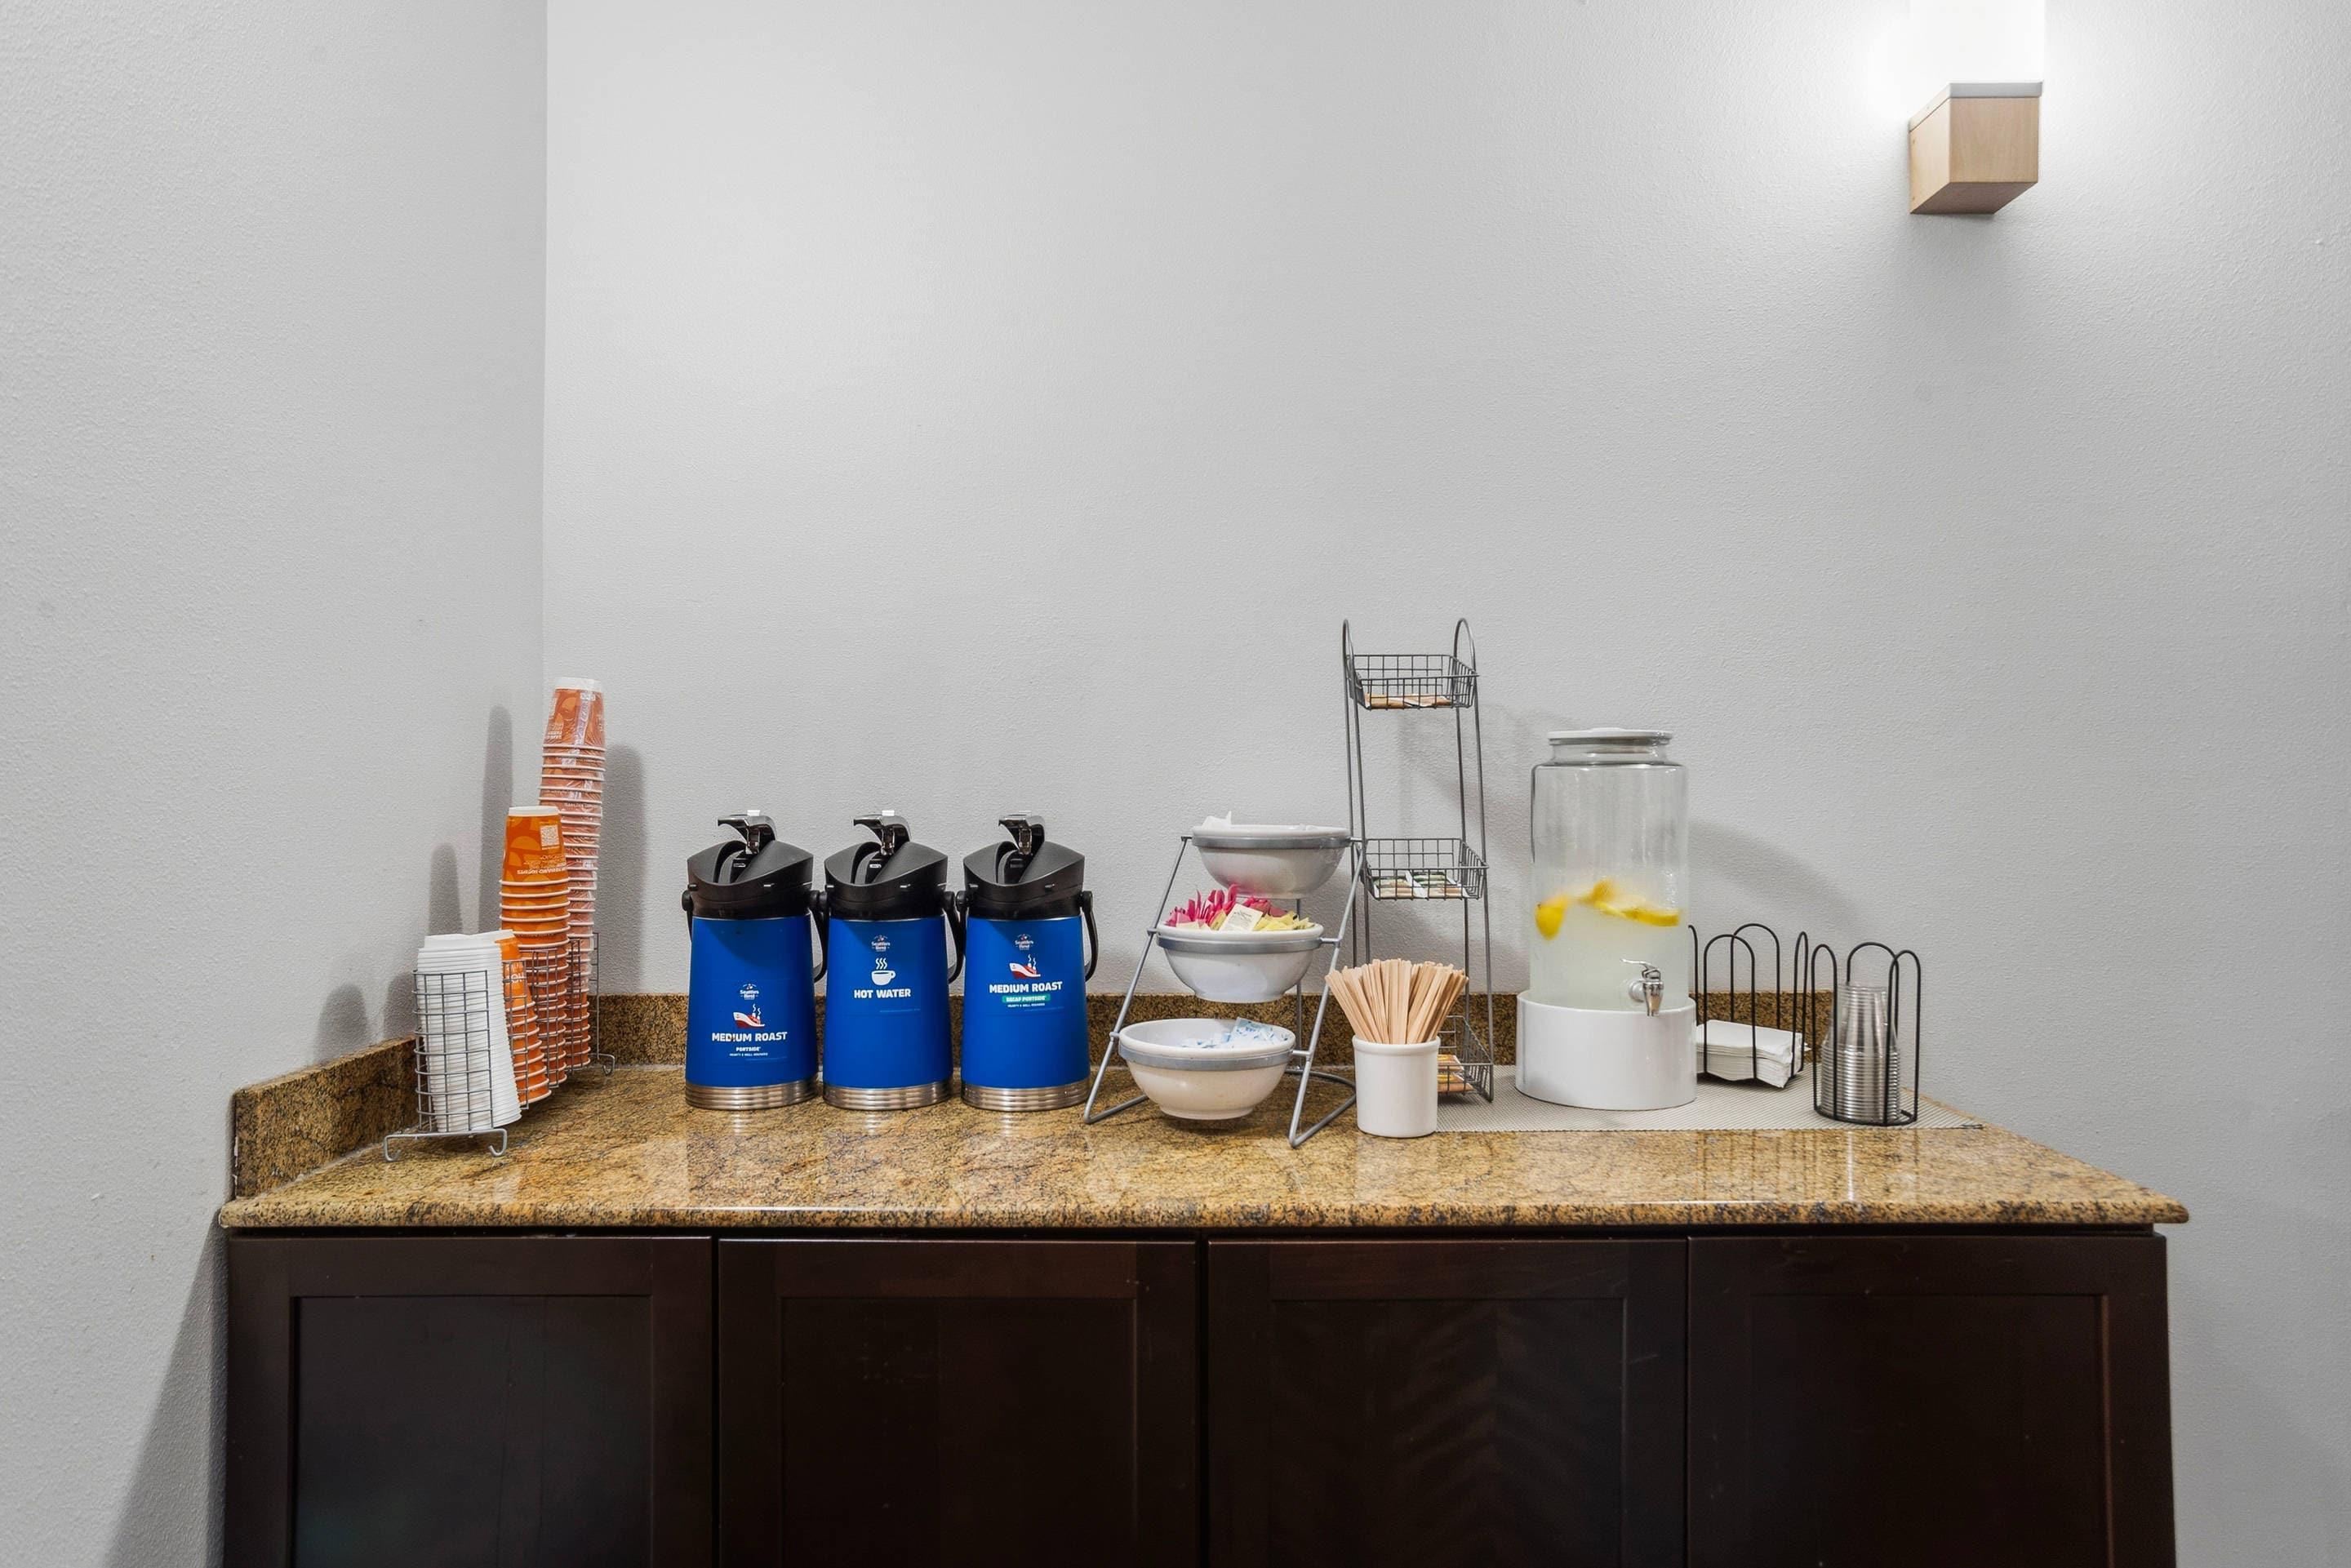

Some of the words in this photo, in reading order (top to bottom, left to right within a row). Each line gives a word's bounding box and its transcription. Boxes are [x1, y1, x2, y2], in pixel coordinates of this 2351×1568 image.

[989, 984, 1029, 993] MEDIUM
[1031, 981, 1063, 993] ROAST
[853, 989, 873, 999] HOT
[876, 988, 911, 998] WATER
[712, 1033, 753, 1042] MEDIUM
[754, 1031, 788, 1042] ROAST
